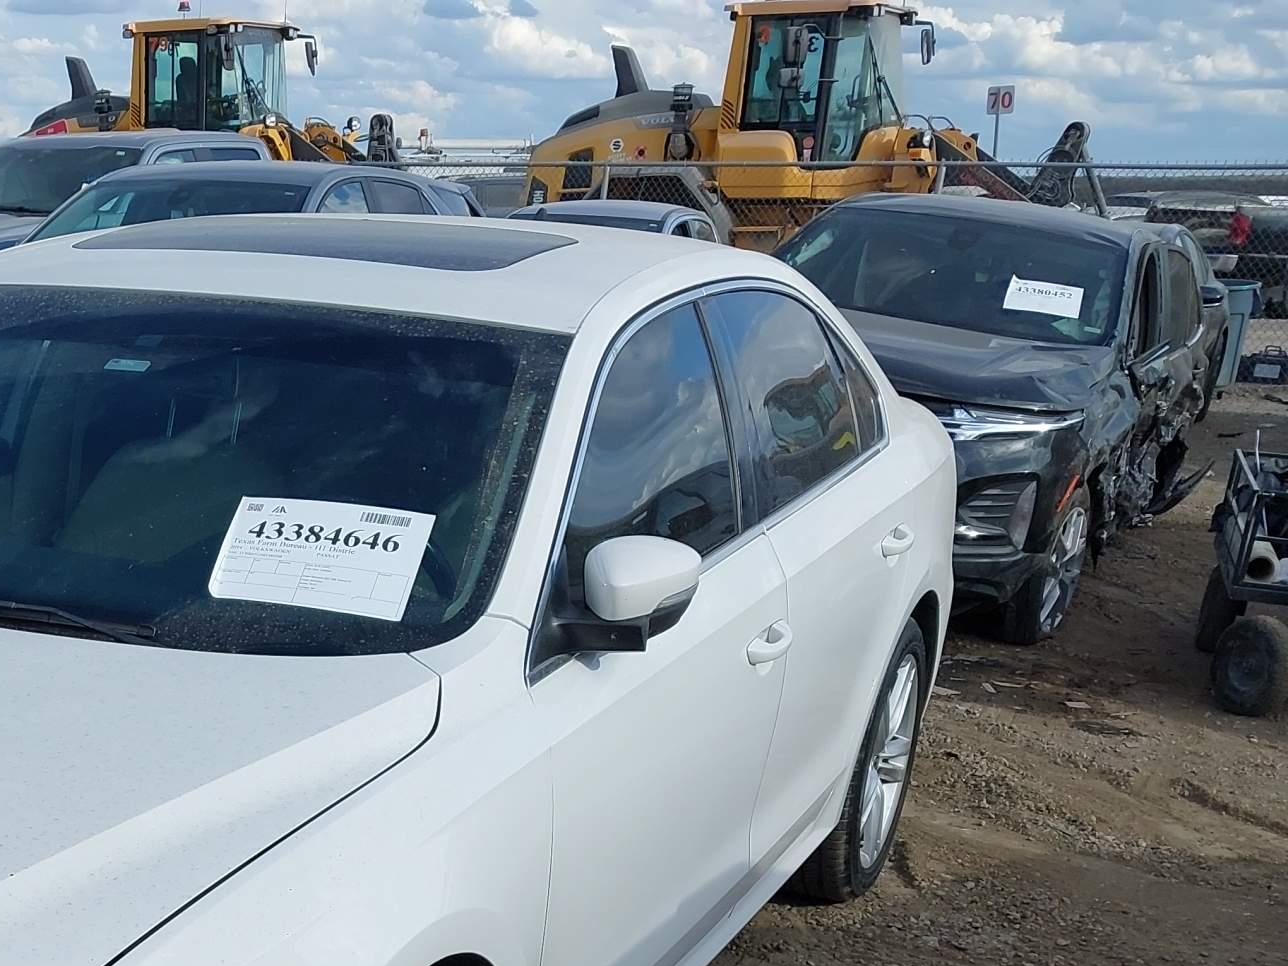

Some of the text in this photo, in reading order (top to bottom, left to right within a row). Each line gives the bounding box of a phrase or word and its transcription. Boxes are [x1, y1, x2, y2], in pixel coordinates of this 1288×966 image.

[989, 91, 1013, 110] 70
[1015, 286, 1073, 299] 43380452
[248, 520, 405, 553] 43384646
